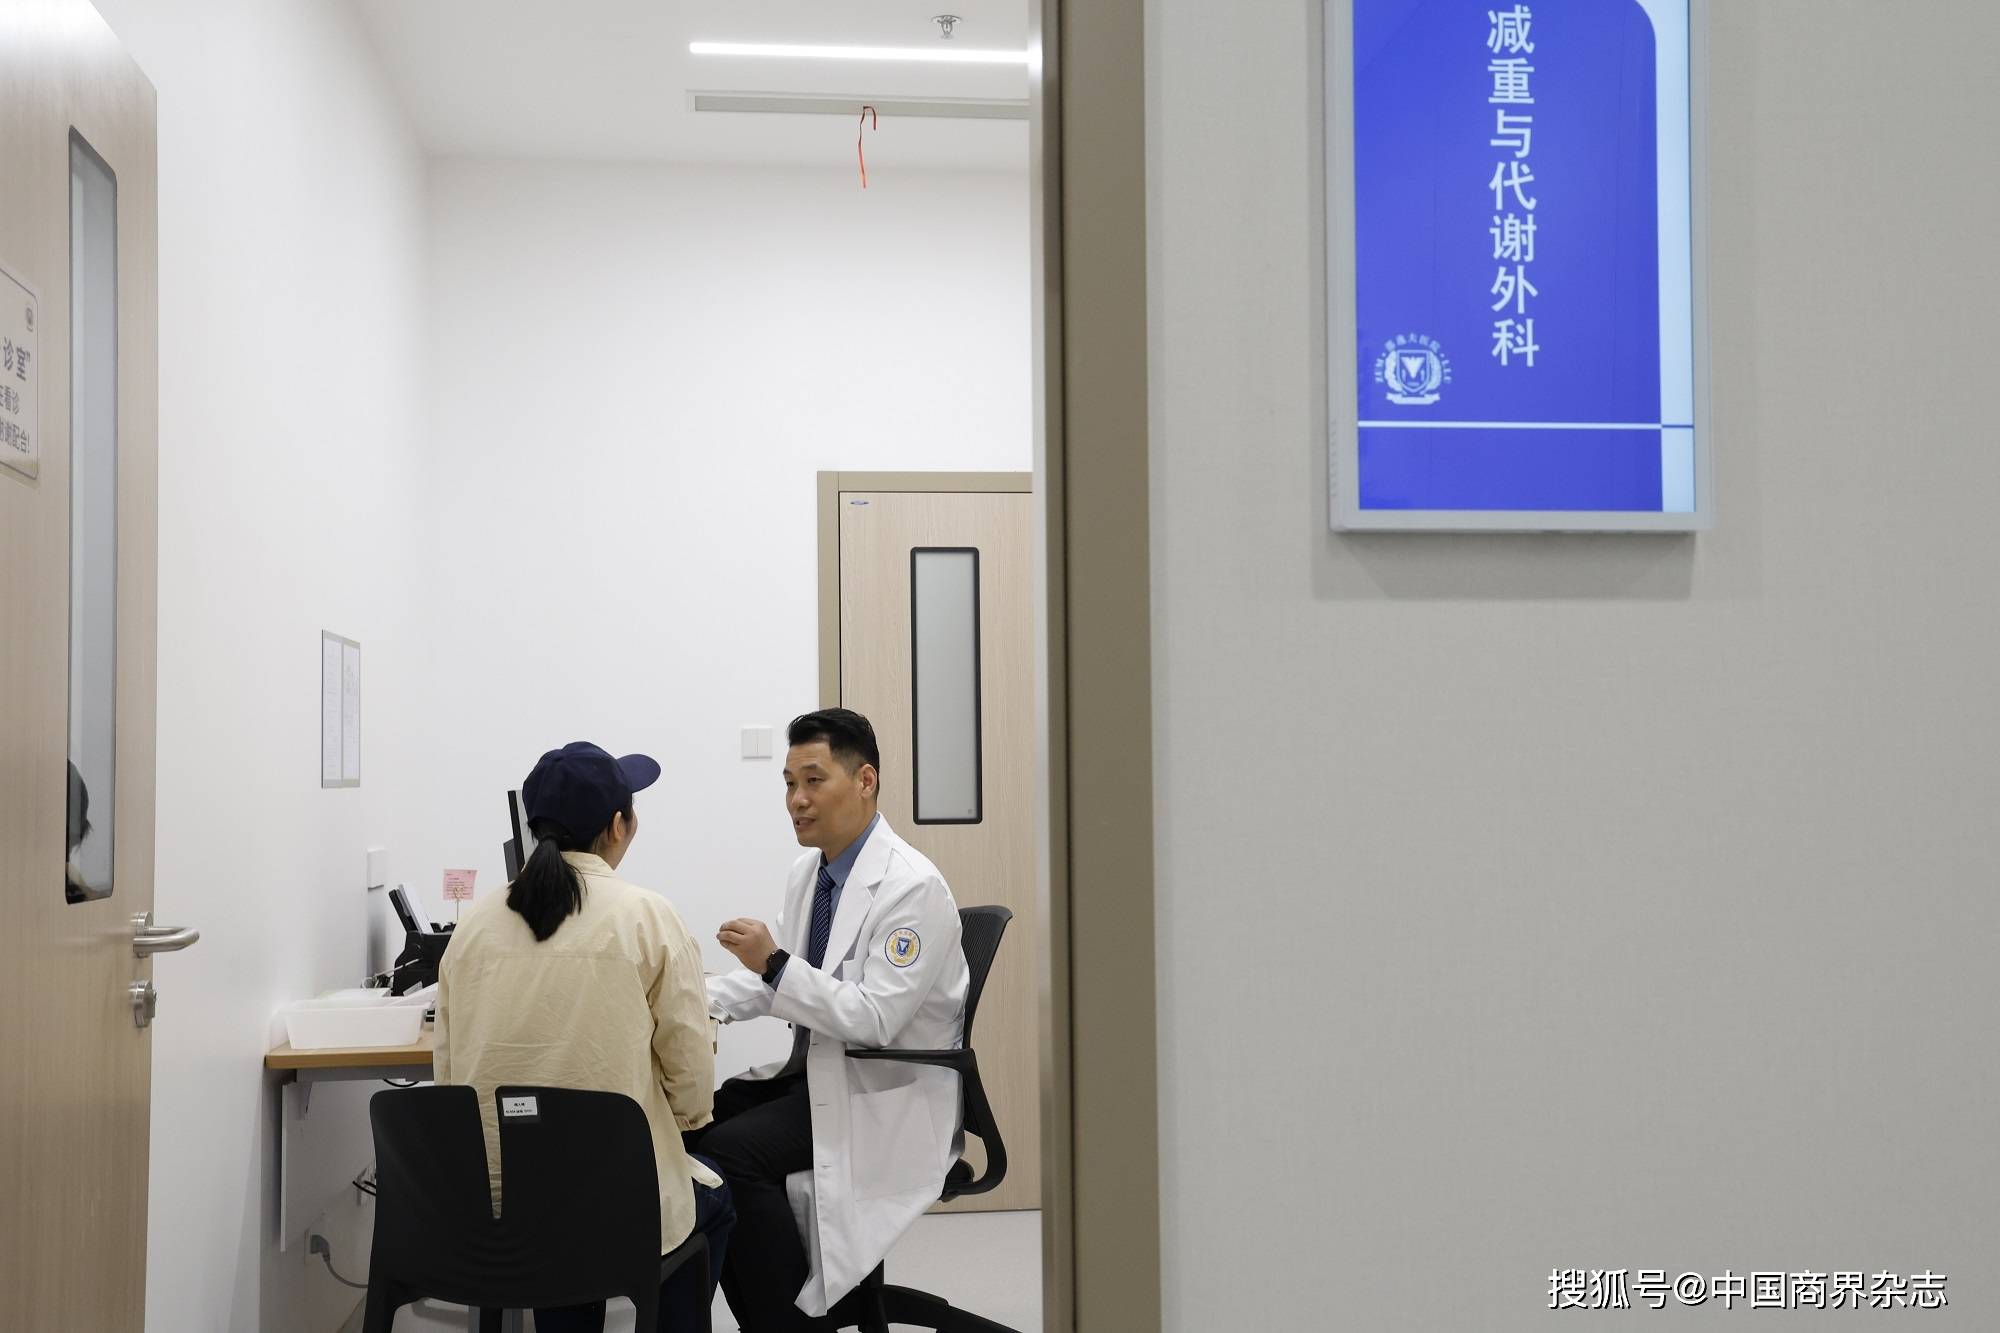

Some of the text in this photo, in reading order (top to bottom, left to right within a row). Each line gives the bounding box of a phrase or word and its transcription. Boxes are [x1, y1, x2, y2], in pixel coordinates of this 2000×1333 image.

[1487, 4, 1540, 367] 减重与代谢外科
